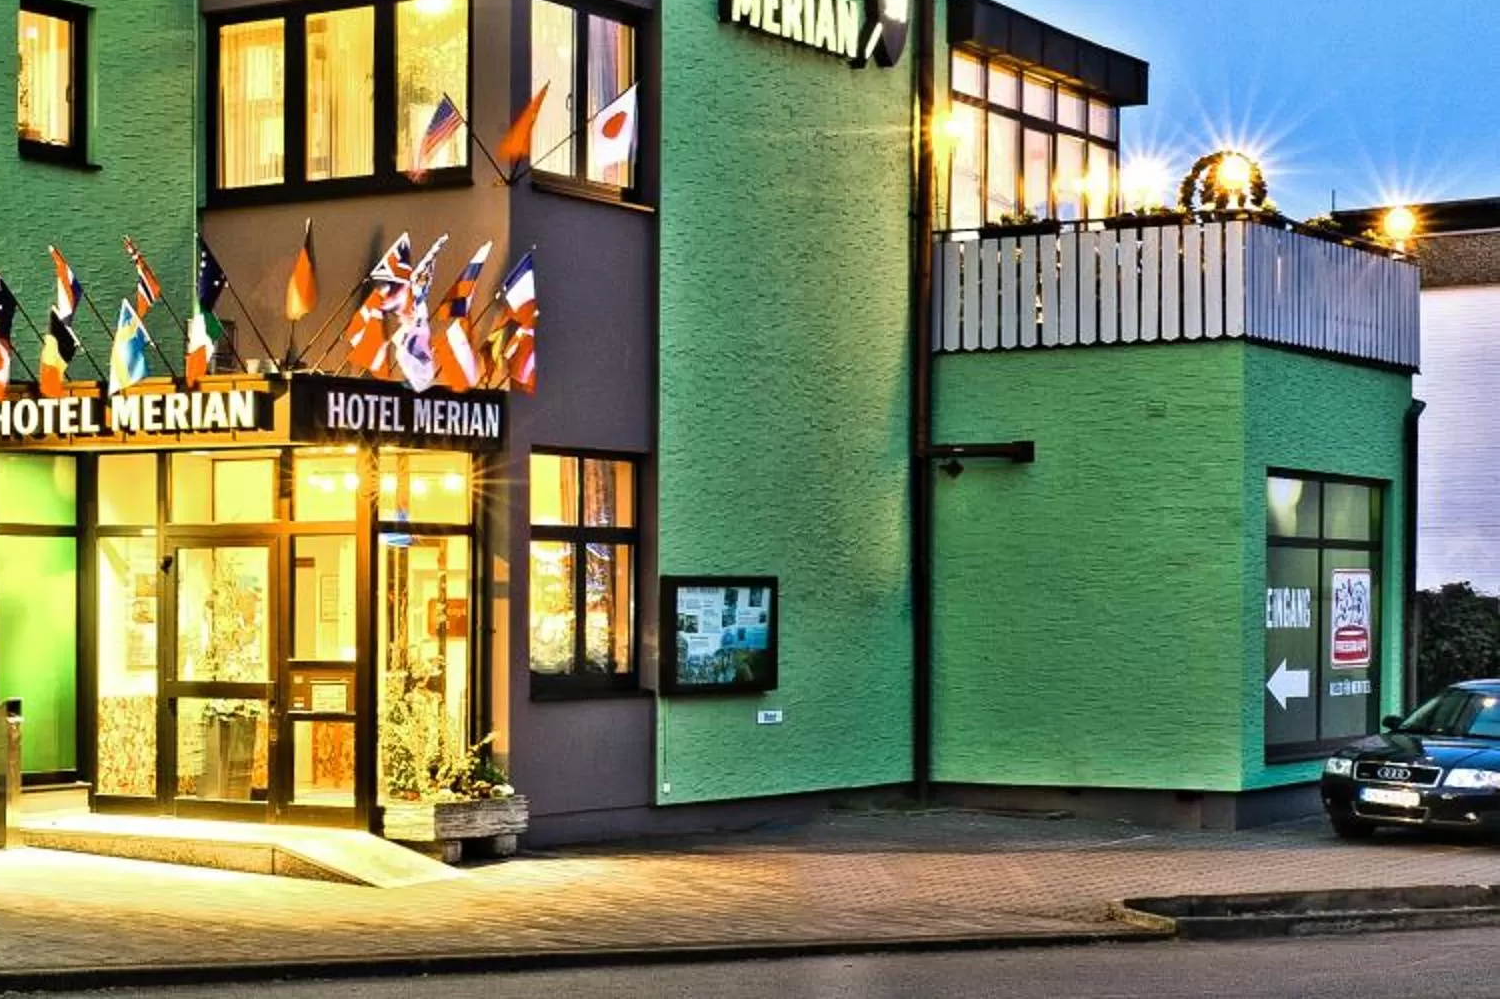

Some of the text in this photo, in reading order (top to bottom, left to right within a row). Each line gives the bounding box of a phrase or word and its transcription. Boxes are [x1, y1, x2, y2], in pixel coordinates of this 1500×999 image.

[110, 389, 255, 432] MERIAN
[327, 392, 500, 439] HOTEL MERIAN
[1265, 587, 1311, 628] EINGANG
